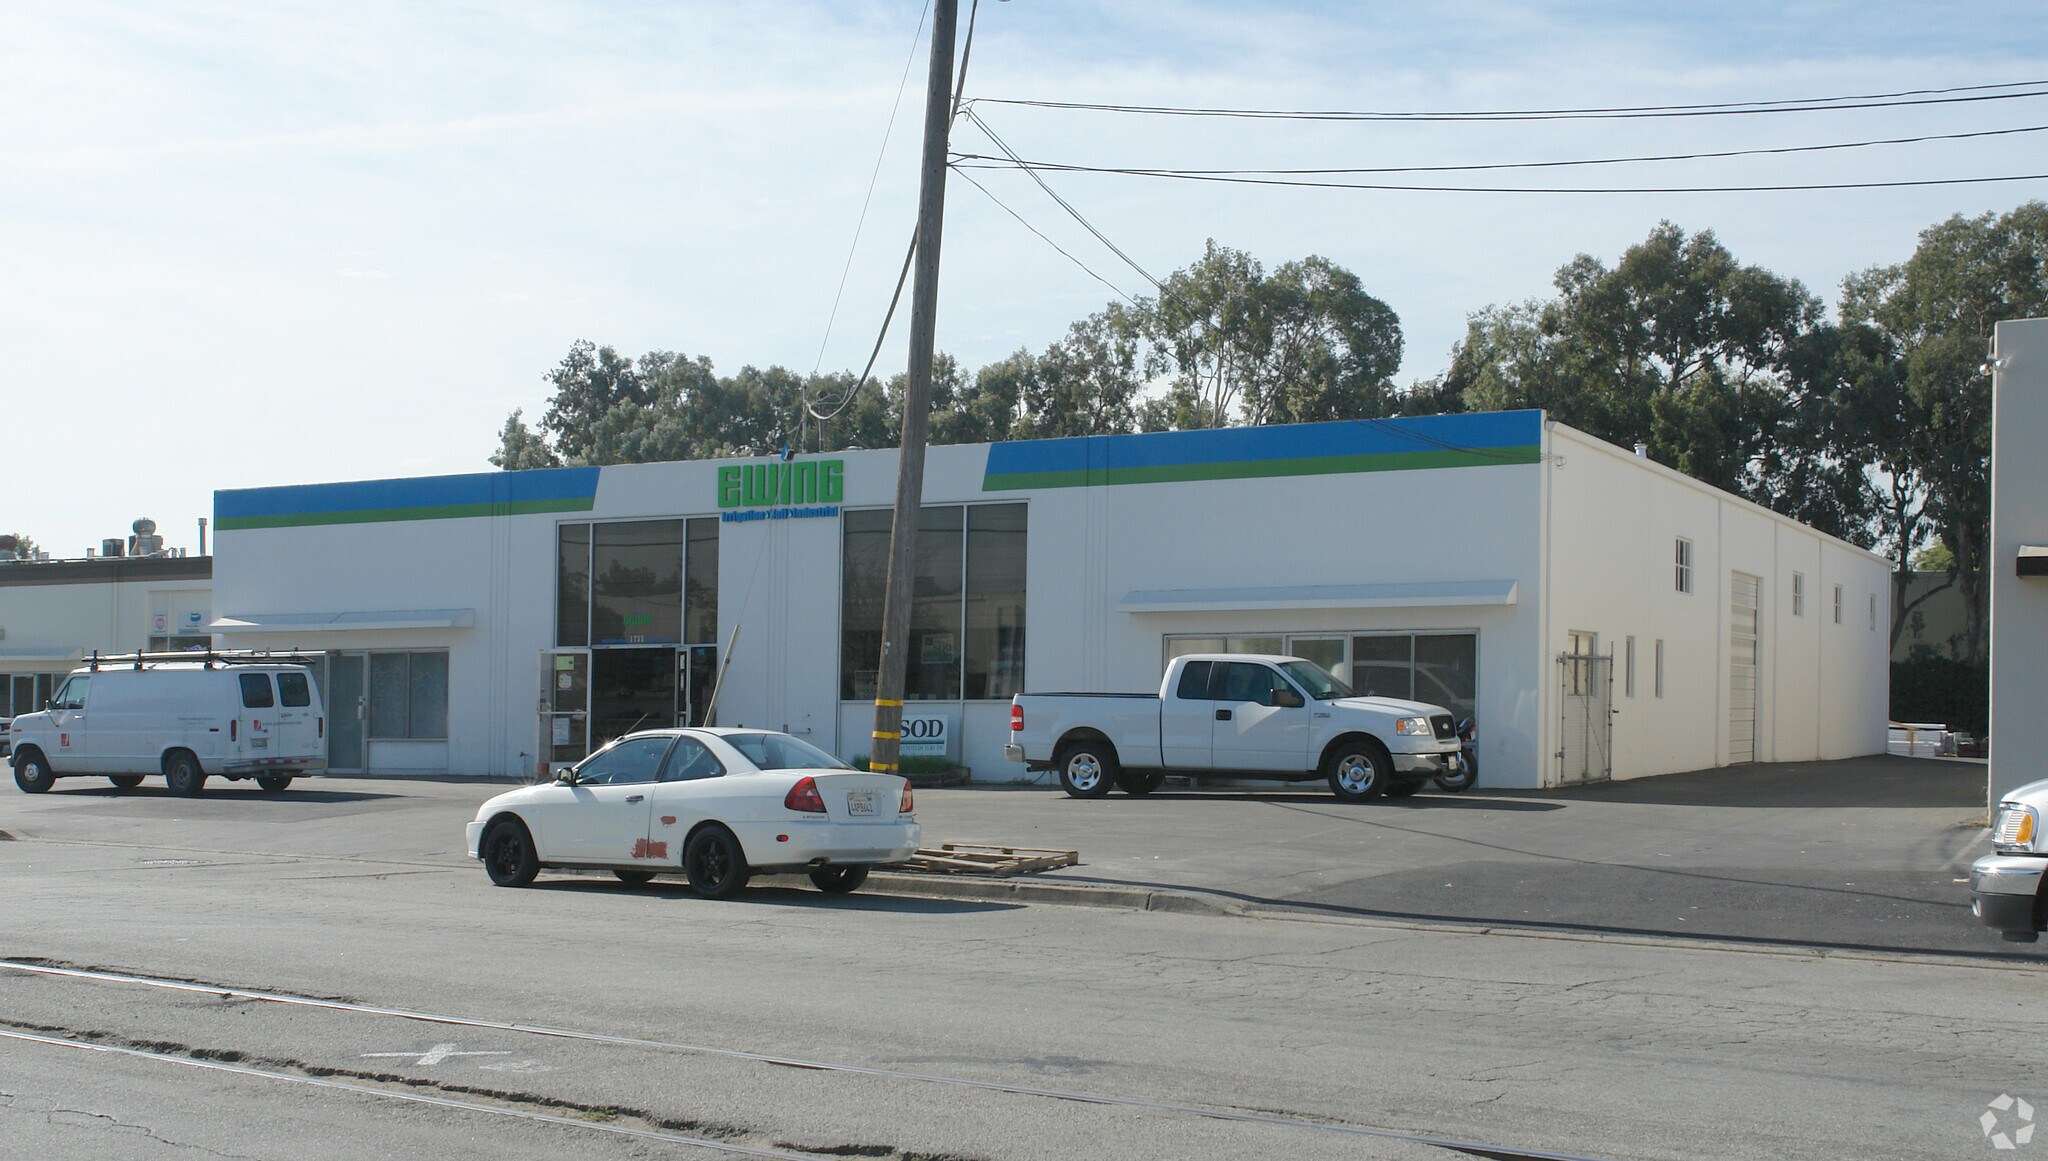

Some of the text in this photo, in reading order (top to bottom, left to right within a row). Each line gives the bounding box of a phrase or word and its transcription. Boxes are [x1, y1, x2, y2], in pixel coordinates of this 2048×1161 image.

[718, 460, 843, 508] EWING
[793, 506, 838, 518] Industrial
[900, 719, 944, 738] SOD
